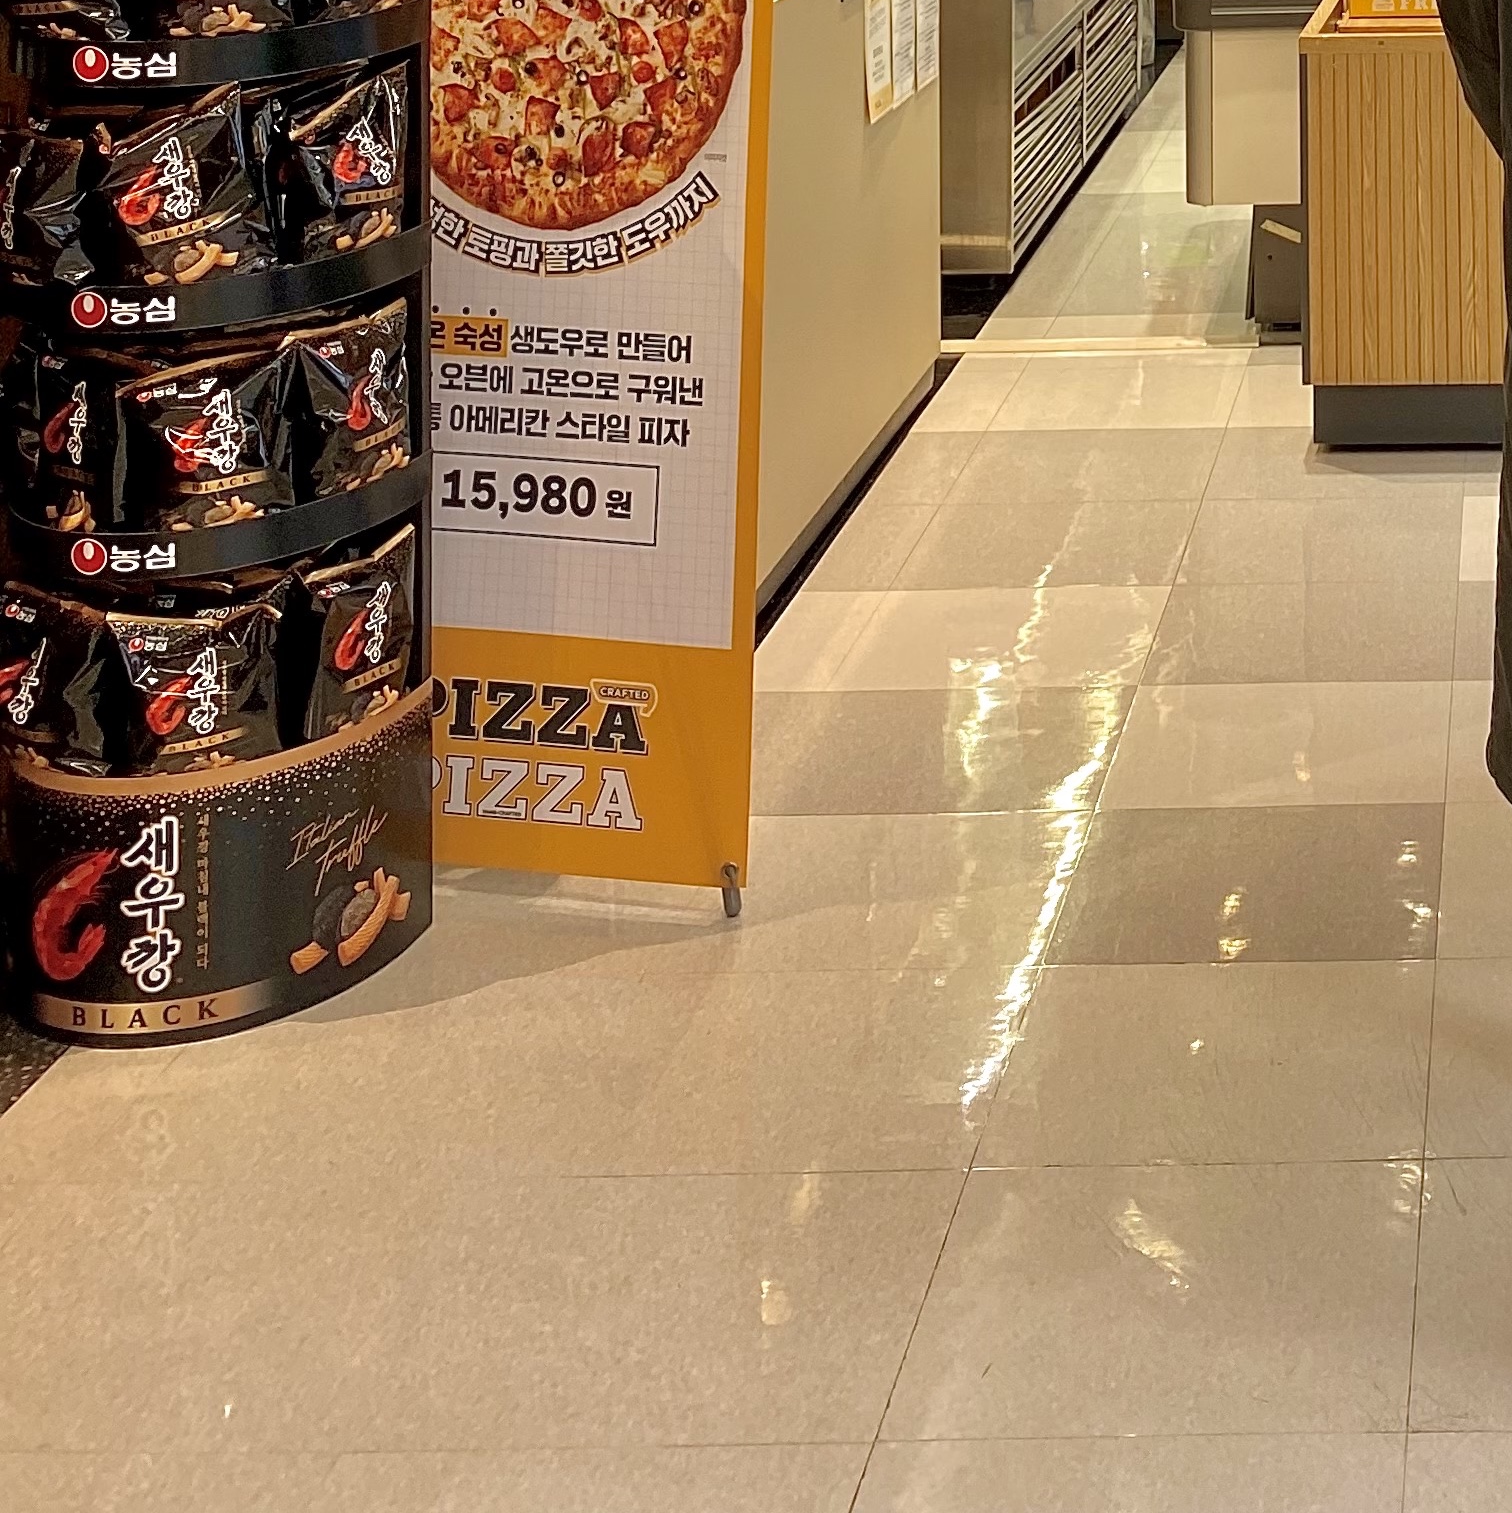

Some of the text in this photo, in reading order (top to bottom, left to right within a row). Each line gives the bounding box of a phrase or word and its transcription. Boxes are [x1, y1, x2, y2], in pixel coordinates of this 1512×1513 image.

[111, 51, 176, 79] 농심
[153, 137, 193, 219] 새우깡
[461, 222, 540, 274] 토핑과
[544, 233, 624, 273] 쫄깃한
[619, 171, 719, 259] 도우까지
[110, 296, 176, 325] 농심
[453, 322, 503, 352] 숙성
[510, 325, 608, 359] 생도우로
[617, 331, 692, 363] 만들어
[439, 363, 703, 406] 오븐에 고온으로 구워낸
[202, 389, 239, 474] 새우깡
[450, 404, 550, 438] 아메리칸
[555, 411, 630, 444] 스타일
[638, 417, 690, 447] 피자
[192, 475, 251, 491] BLACK
[441, 469, 632, 520] 15,980 원
[110, 543, 176, 572] 농심
[364, 581, 392, 663] 새우깡
[187, 647, 220, 734] 새우깡
[599, 687, 649, 700] CRAFTED
[168, 733, 230, 753] BLACK
[286, 808, 360, 870] Italian
[120, 815, 185, 993] 새우깡
[72, 998, 219, 1030] BLACK
